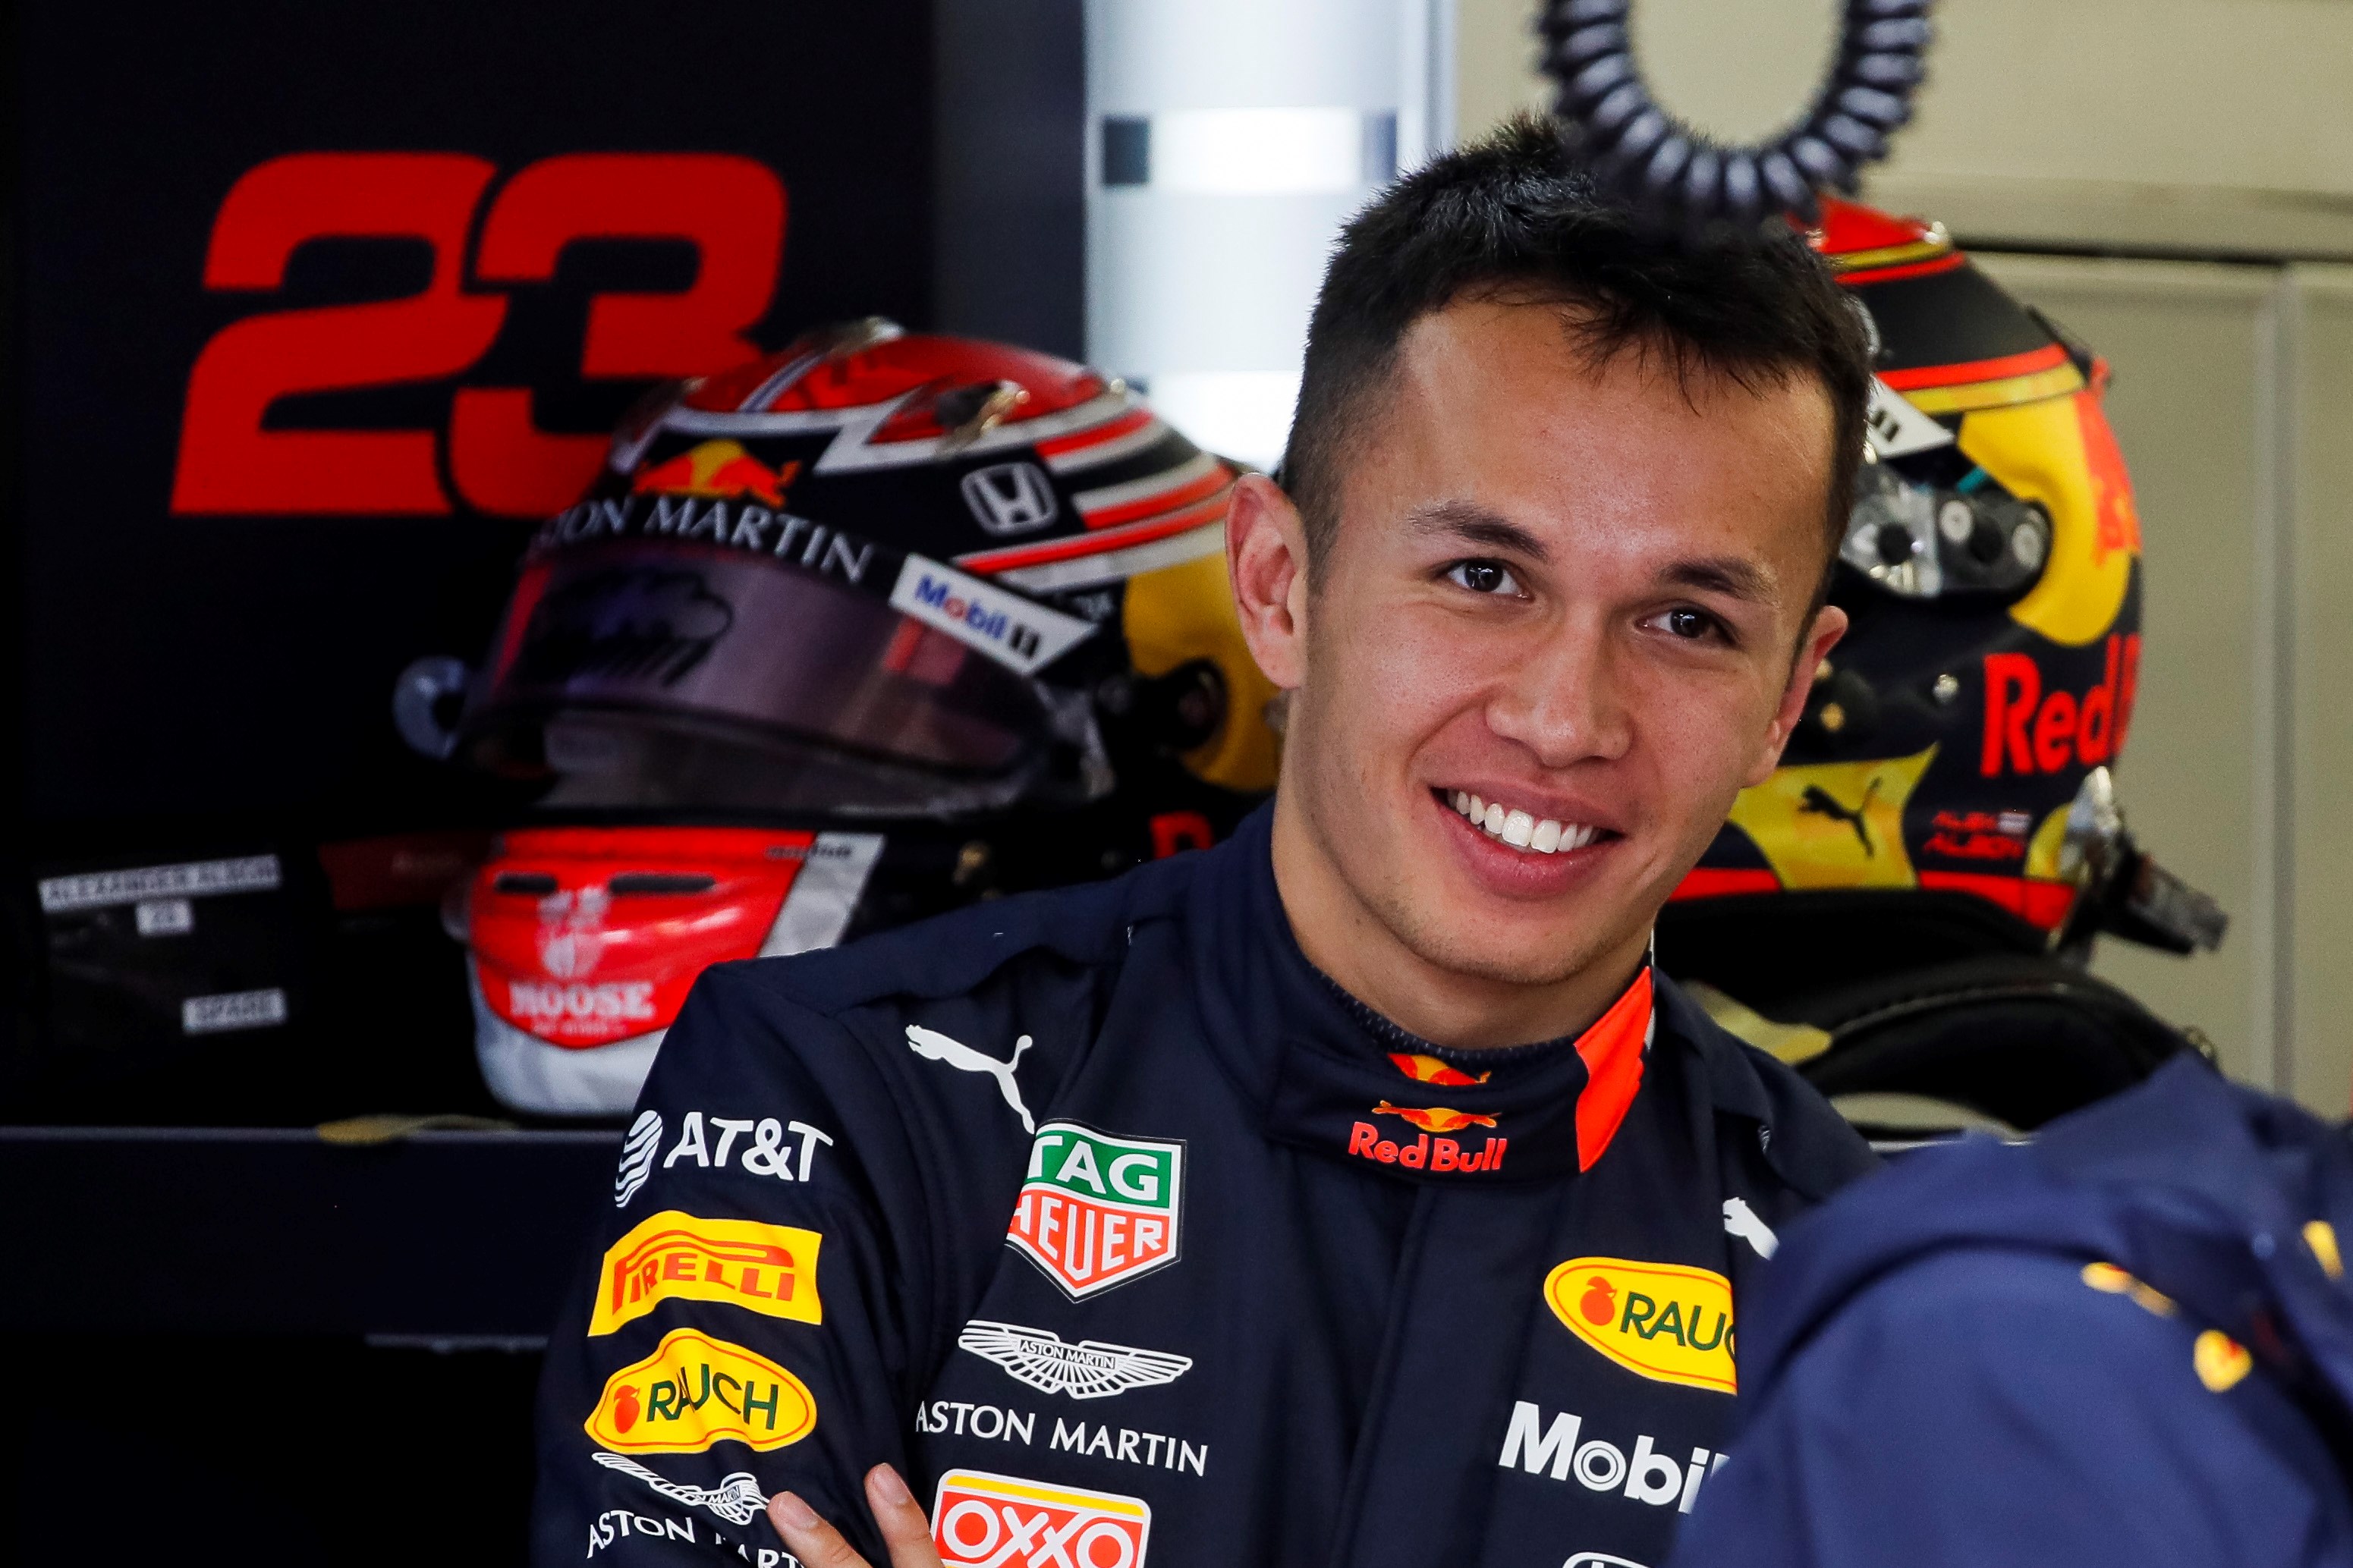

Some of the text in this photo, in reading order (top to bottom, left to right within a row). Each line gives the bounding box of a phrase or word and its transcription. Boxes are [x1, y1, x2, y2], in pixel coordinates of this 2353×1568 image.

[169, 151, 789, 517] 23
[643, 495, 873, 584] MARTIN
[914, 574, 1008, 639] Mobil
[1980, 633, 2120, 777] Red
[509, 982, 656, 1017] MOOSE
[662, 1111, 834, 1183] AT&T
[1027, 1135, 1159, 1202] TAG
[1348, 1121, 1508, 1172] Red Bull
[612, 1229, 795, 1315] PIRELLI
[1013, 1194, 1164, 1281] HEUER
[1021, 1340, 1115, 1369] ASTON MARTIN
[646, 1363, 779, 1430] RAUCH
[916, 1400, 1208, 1477] ASTON MARTIN
[1499, 1400, 1730, 1515] Mobi
[587, 1510, 696, 1559] ASTON
[942, 1499, 1134, 1568] OXXO
